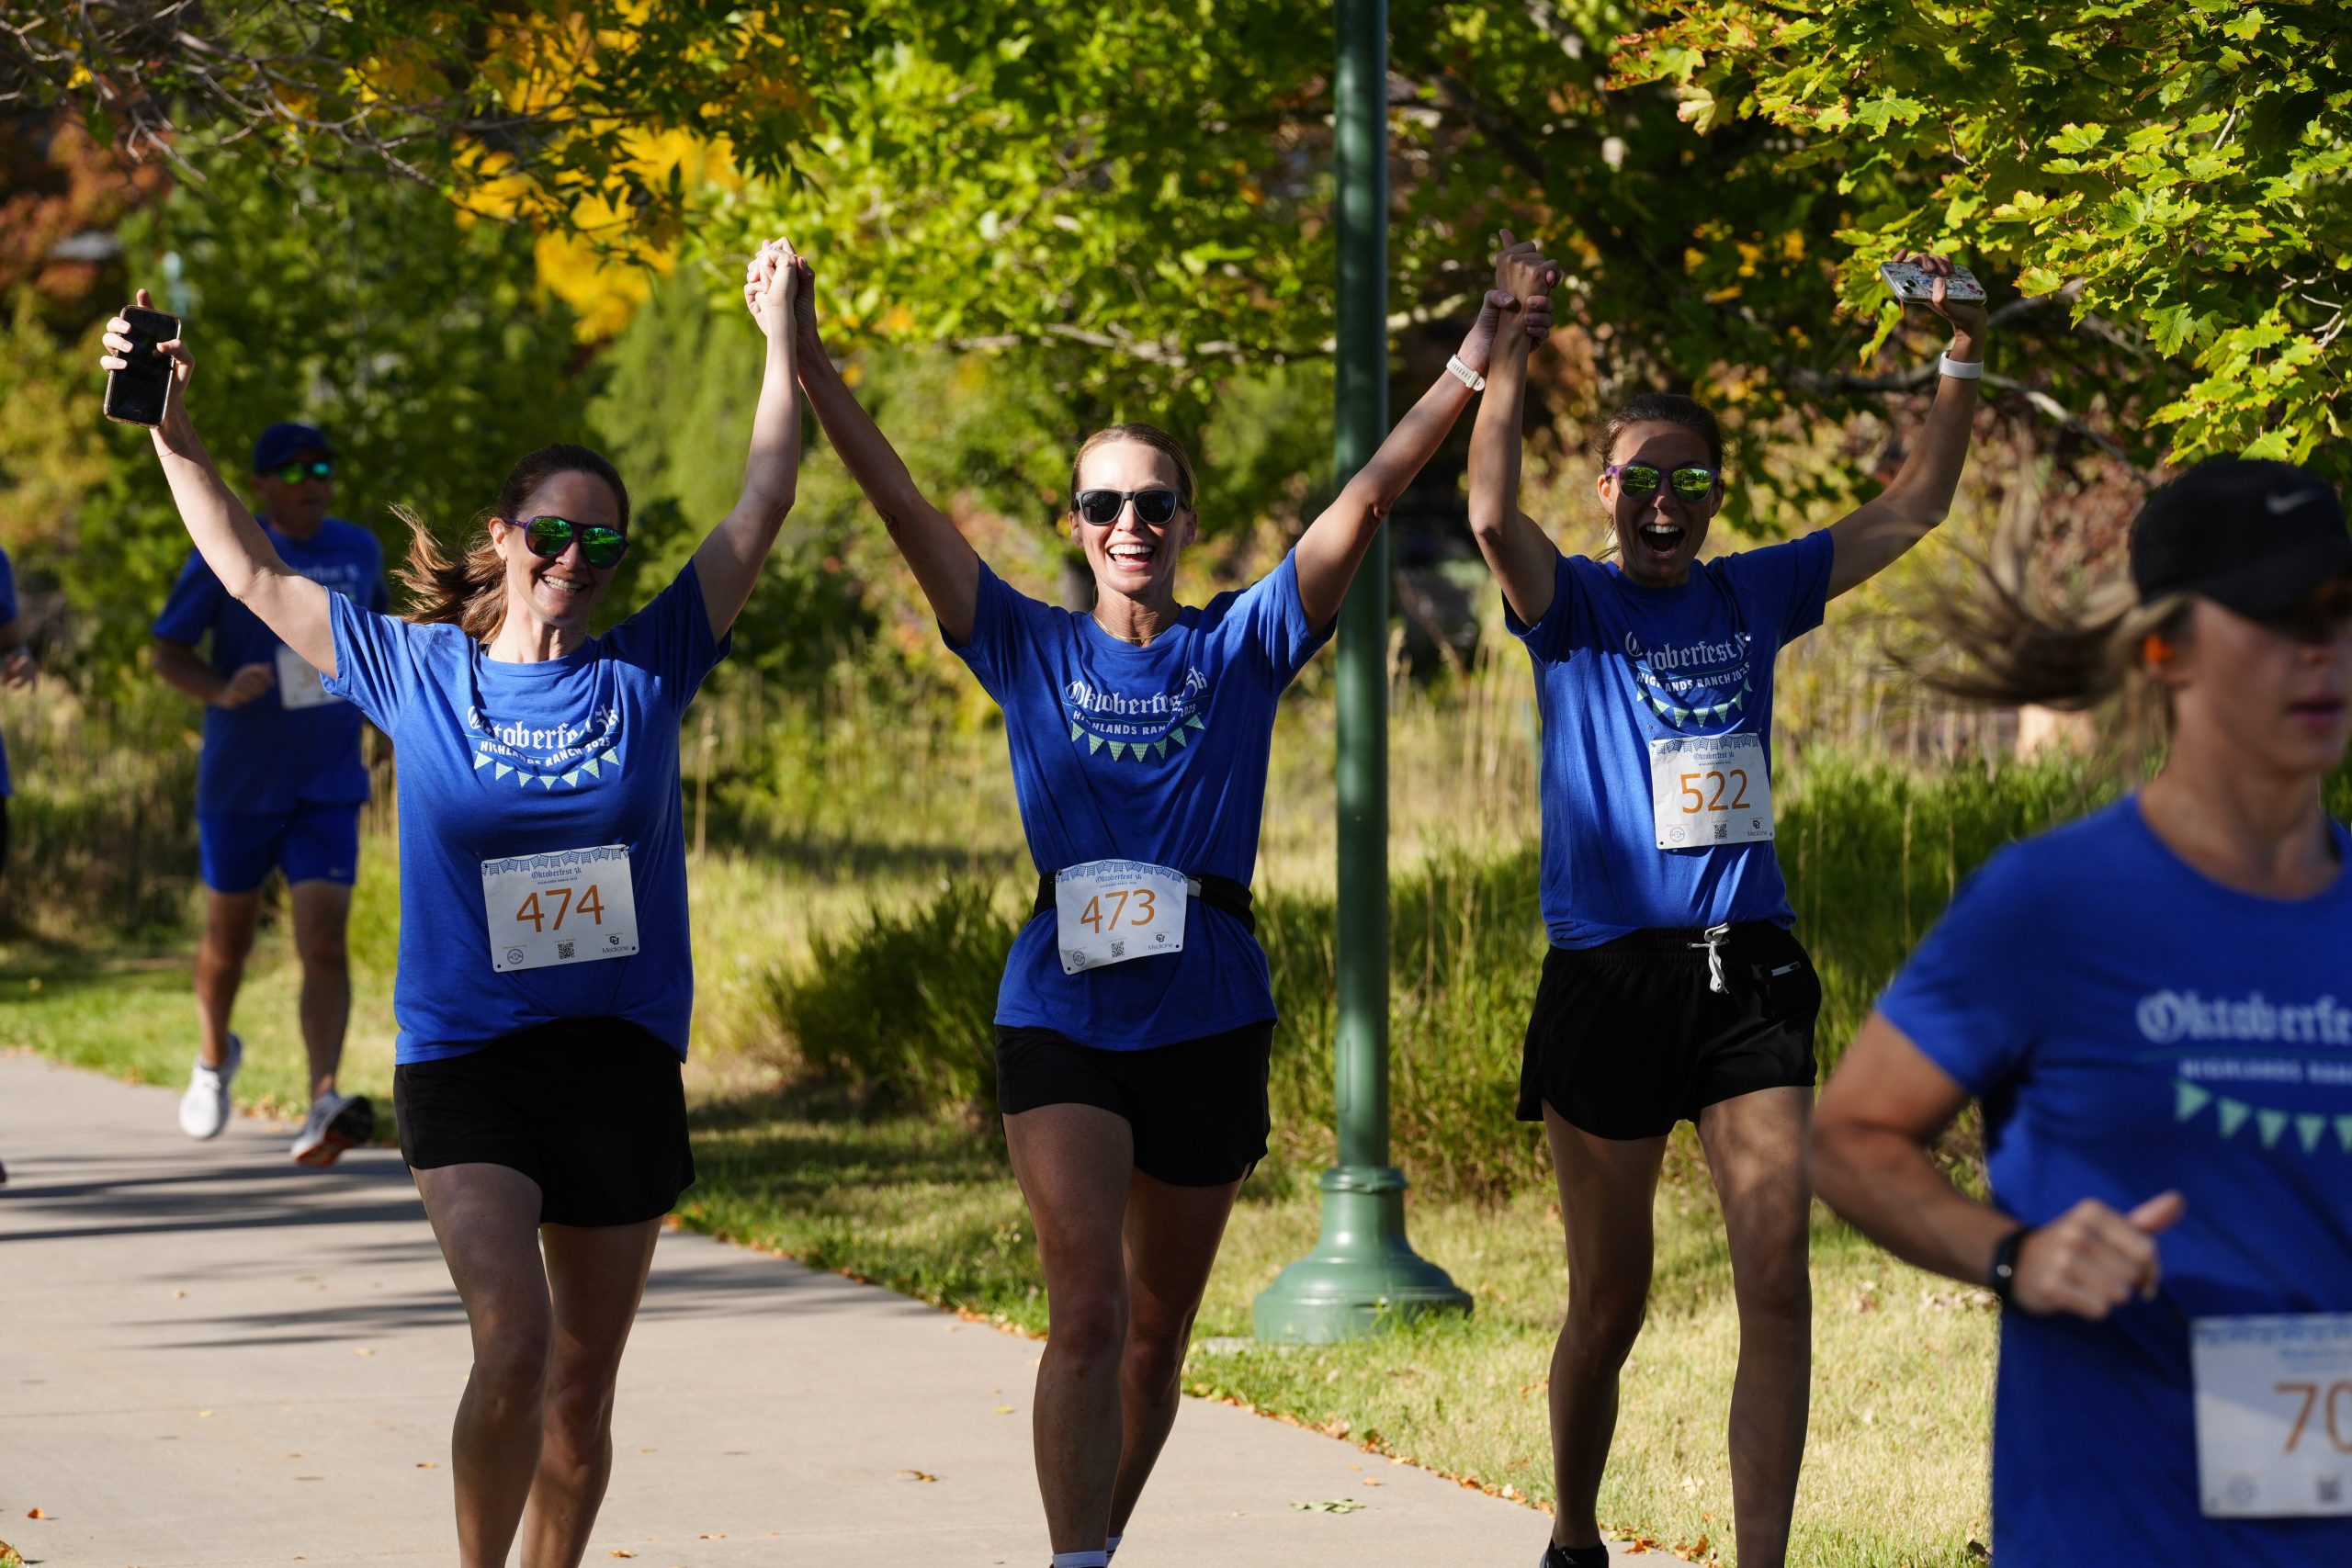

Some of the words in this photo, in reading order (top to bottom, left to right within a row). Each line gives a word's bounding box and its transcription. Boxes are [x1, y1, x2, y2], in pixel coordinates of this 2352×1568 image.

[1696, 674, 1732, 690] RANCH
[1073, 710, 1138, 736] HIHLANDS
[545, 748, 583, 767] RANCH
[584, 736, 611, 753] 2025
[1680, 769, 1751, 814] 522
[531, 867, 571, 879] Oktoberfest
[516, 884, 605, 933] 474
[1080, 889, 1156, 934] 473
[602, 945, 629, 953] Medicine
[2273, 1380, 2352, 1455] 70
